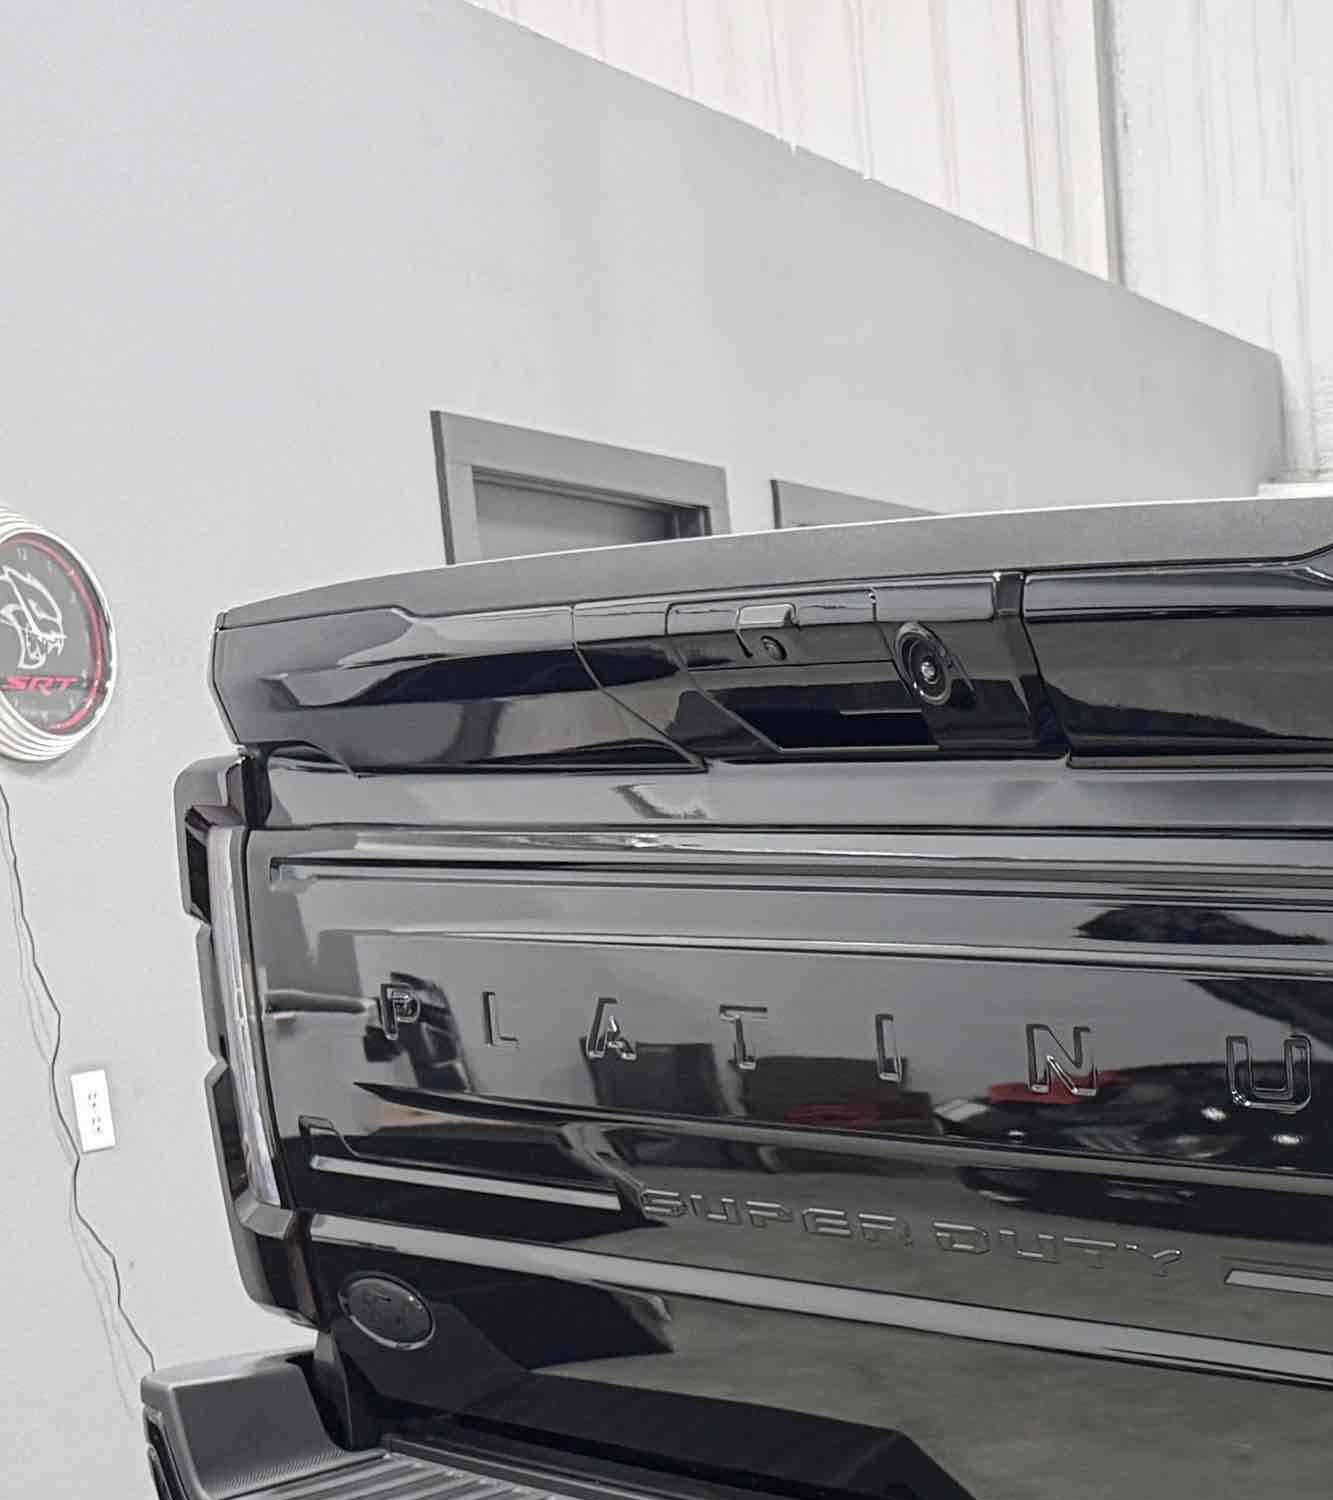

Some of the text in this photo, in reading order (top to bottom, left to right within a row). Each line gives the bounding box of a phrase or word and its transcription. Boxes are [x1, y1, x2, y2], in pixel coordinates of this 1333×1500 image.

[4, 676, 81, 696] SRT
[640, 1188, 1184, 1279] SUPER DUTY
